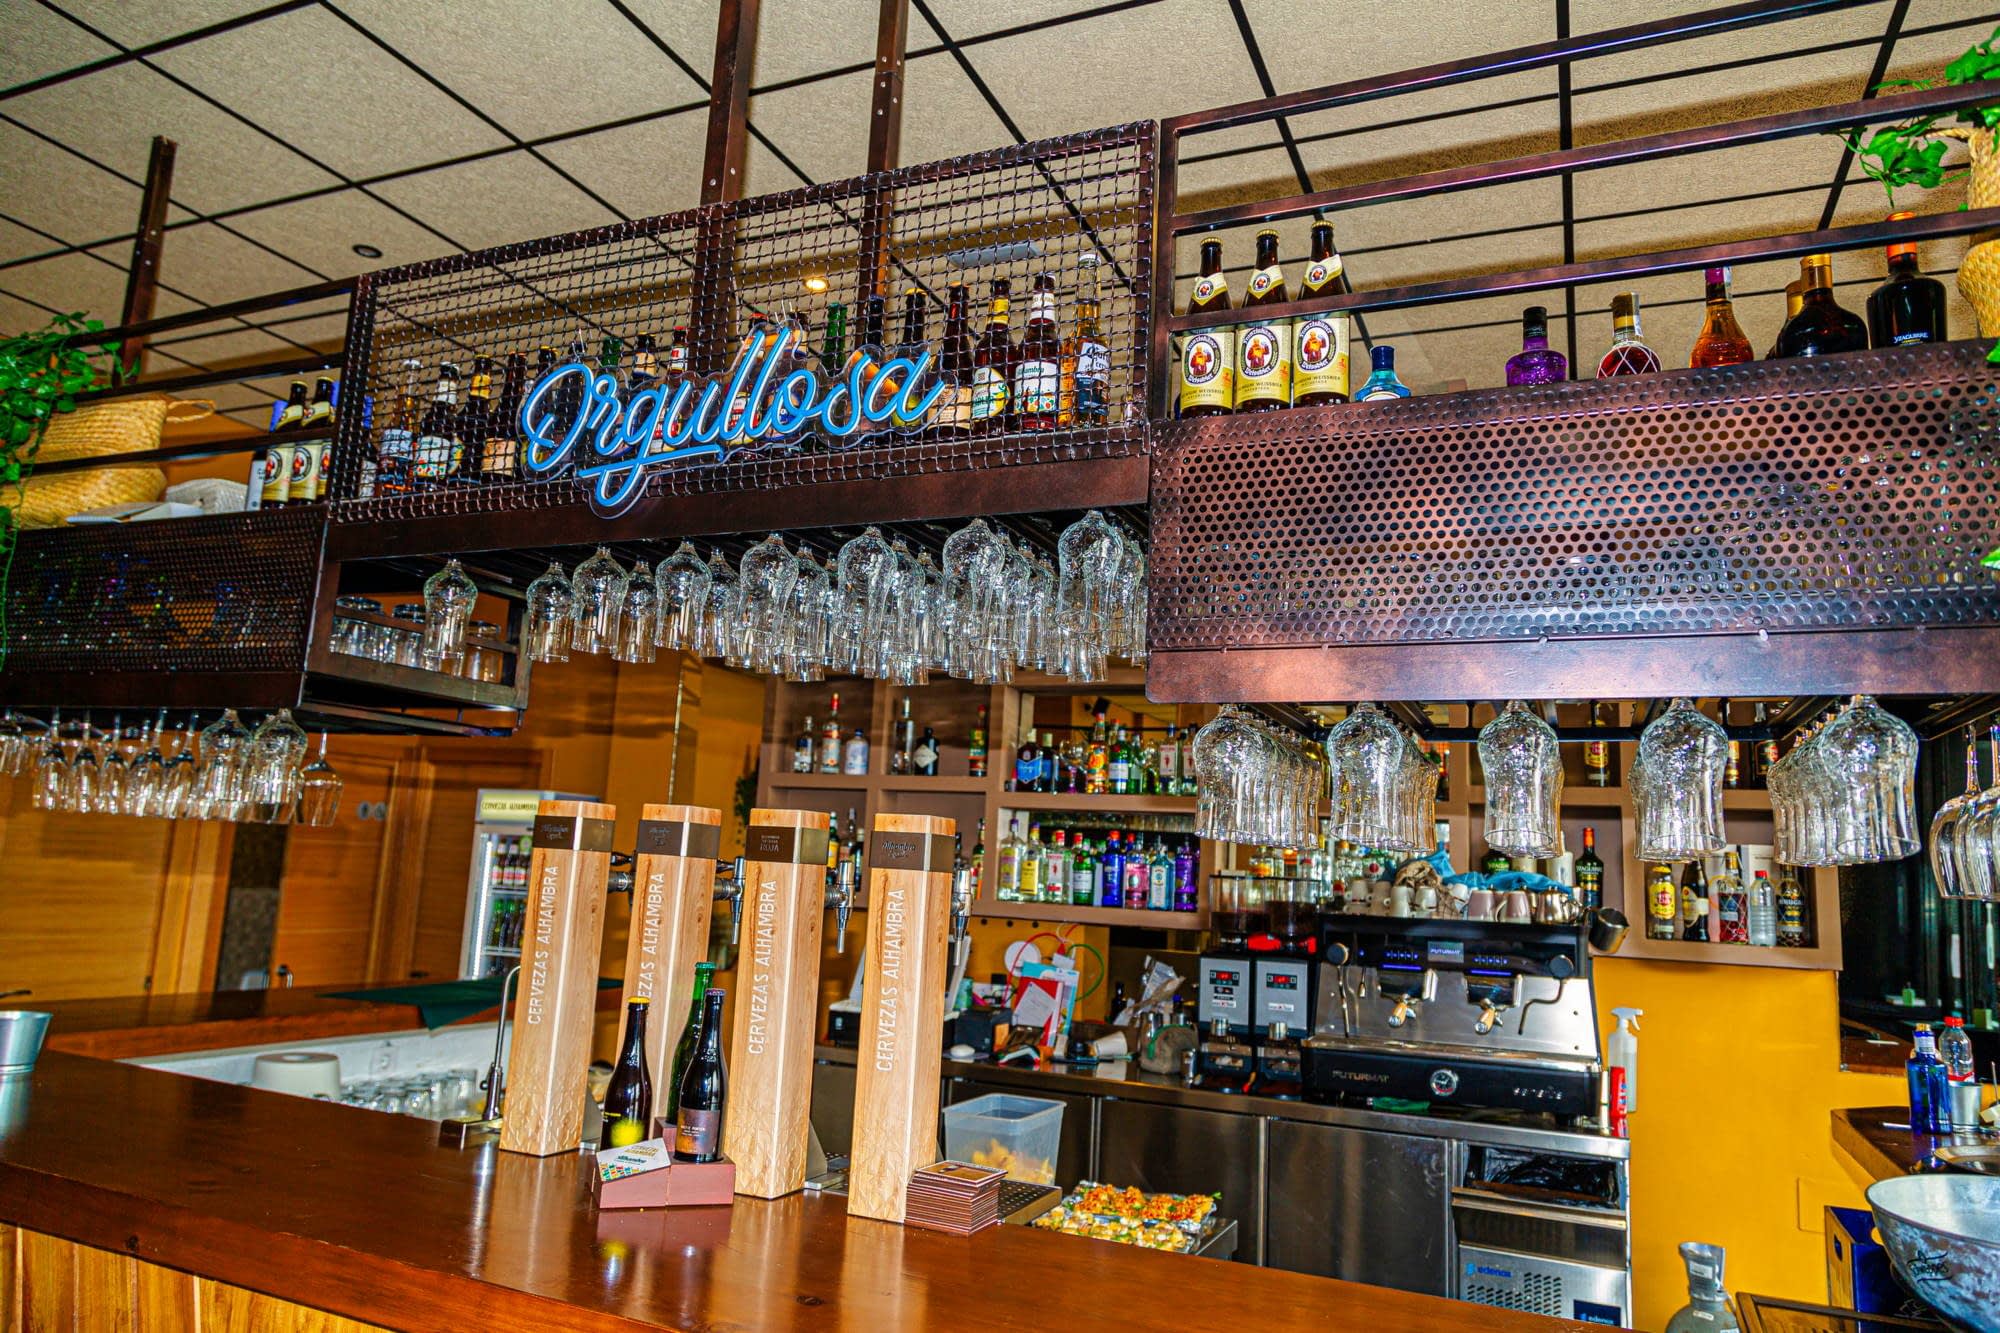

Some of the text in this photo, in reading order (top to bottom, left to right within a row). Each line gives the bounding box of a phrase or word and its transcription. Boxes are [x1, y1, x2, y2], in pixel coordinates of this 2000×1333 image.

[521, 326, 947, 508] Orgullosa
[537, 866, 559, 945] ALHAMBRA
[642, 873, 665, 955] ALHAMBRA
[528, 950, 549, 1025] CERVEZAS
[748, 880, 777, 1055] CERVEZAS ALHAMBRA
[876, 888, 905, 1072] CERVEZAS ALHAMBRA
[1332, 1069, 1390, 1083] FUTURMAT
[1477, 1266, 1512, 1278] edenox
